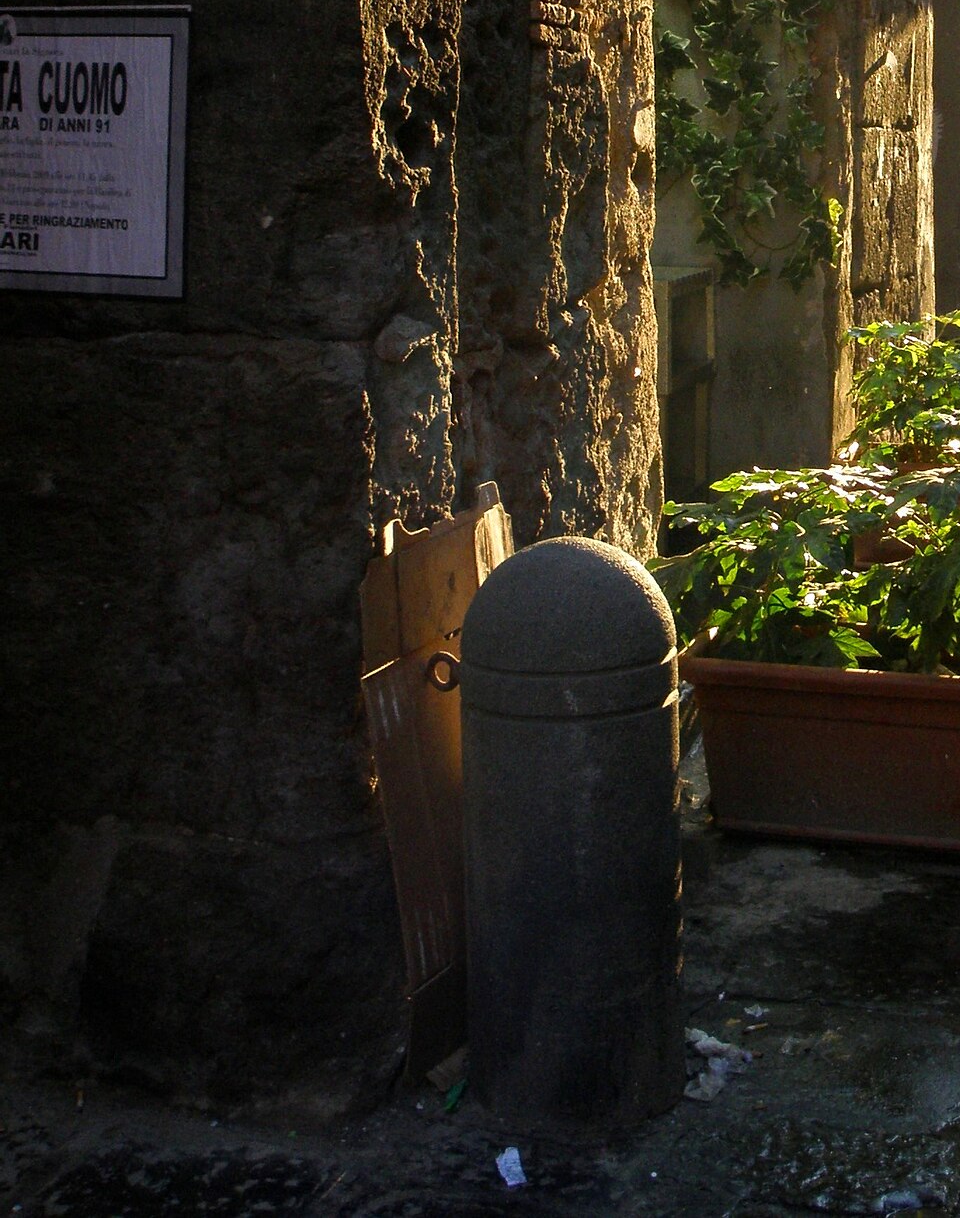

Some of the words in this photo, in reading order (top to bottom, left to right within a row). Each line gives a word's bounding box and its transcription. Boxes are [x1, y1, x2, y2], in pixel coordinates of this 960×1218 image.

[38, 61, 128, 116] CUOMO
[39, 118, 53, 132] DI
[57, 118, 91, 133] ANNI
[95, 119, 111, 134] 91
[9, 213, 30, 225] PER
[32, 214, 129, 231] RINGRAZIAMENTO
